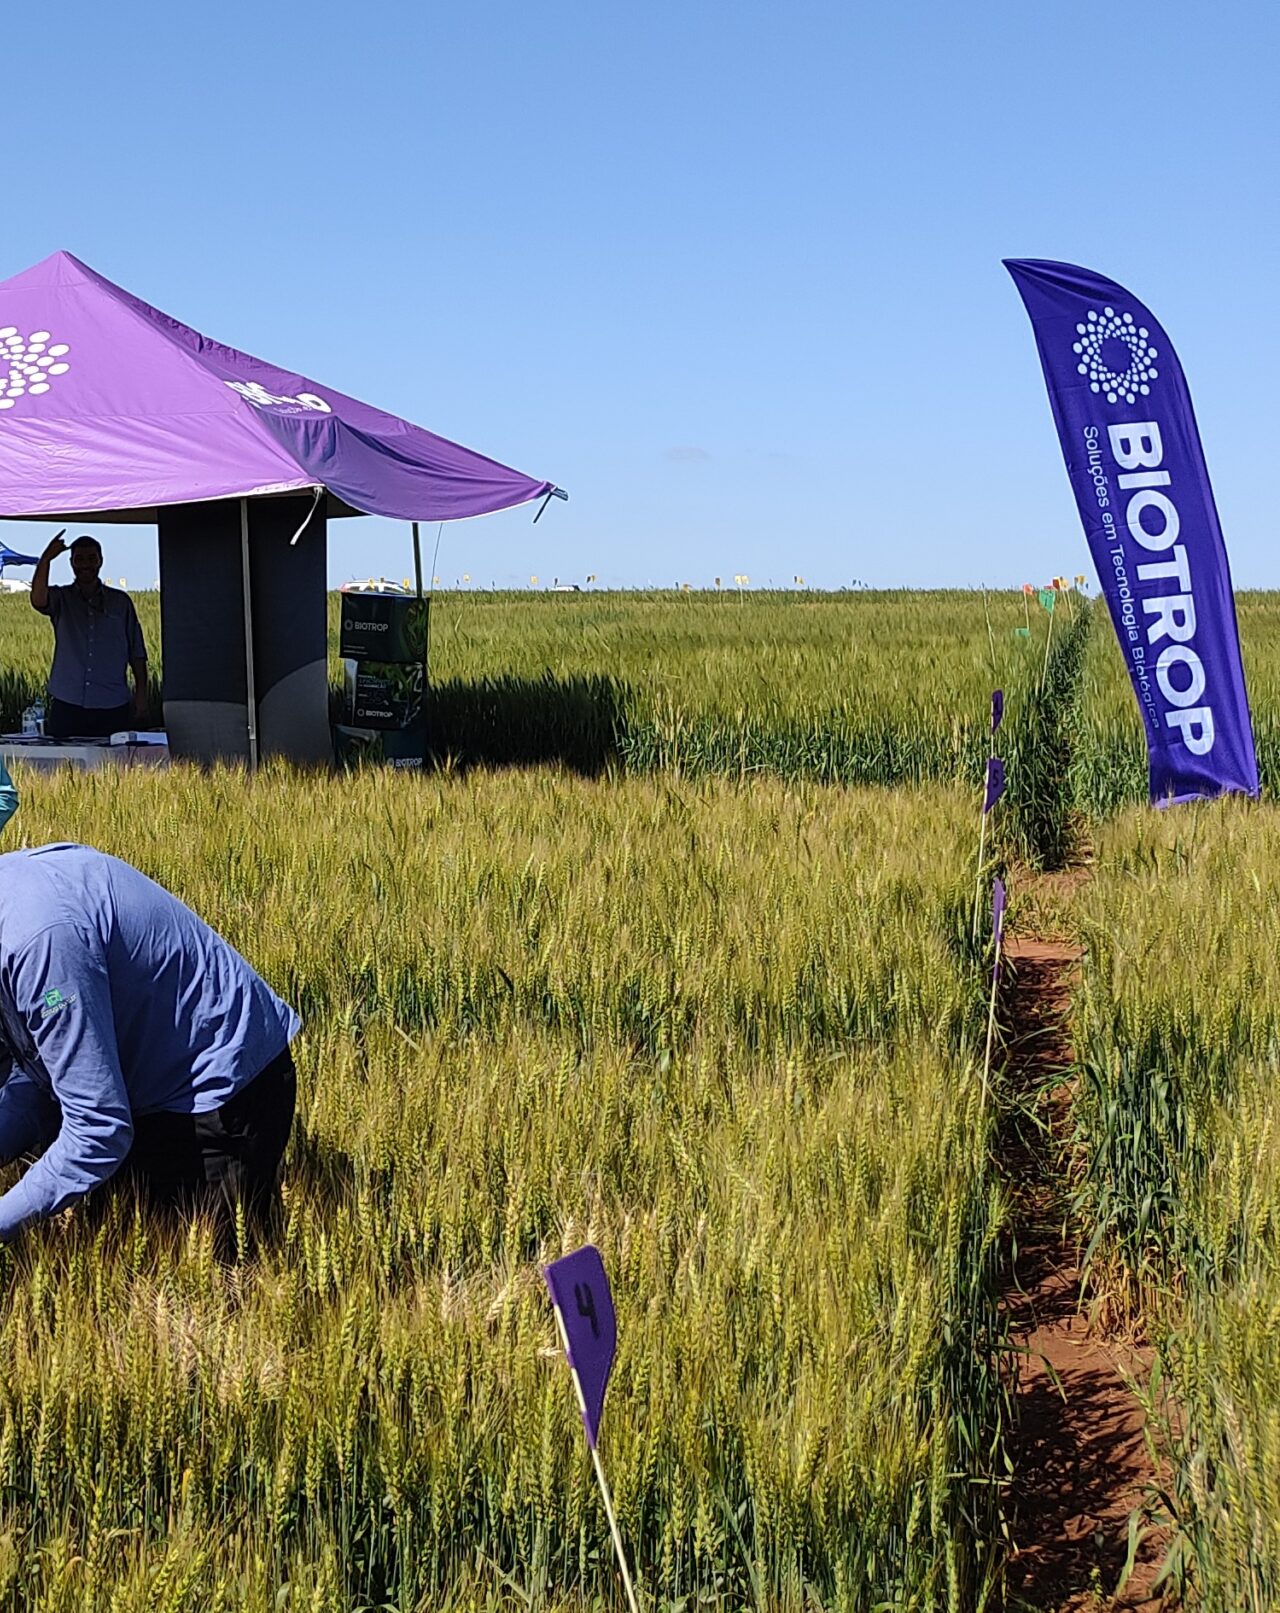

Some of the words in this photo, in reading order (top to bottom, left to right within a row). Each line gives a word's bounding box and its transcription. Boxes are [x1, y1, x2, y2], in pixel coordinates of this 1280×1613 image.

[1083, 426, 1109, 508] Soluções
[1102, 512, 1117, 540] em
[1110, 544, 1140, 641] Tecnologia
[1107, 421, 1215, 756] BIOTROP
[354, 621, 389, 632] BIOTROP
[365, 709, 394, 718] BIOTROP
[575, 1282, 599, 1340] 4
